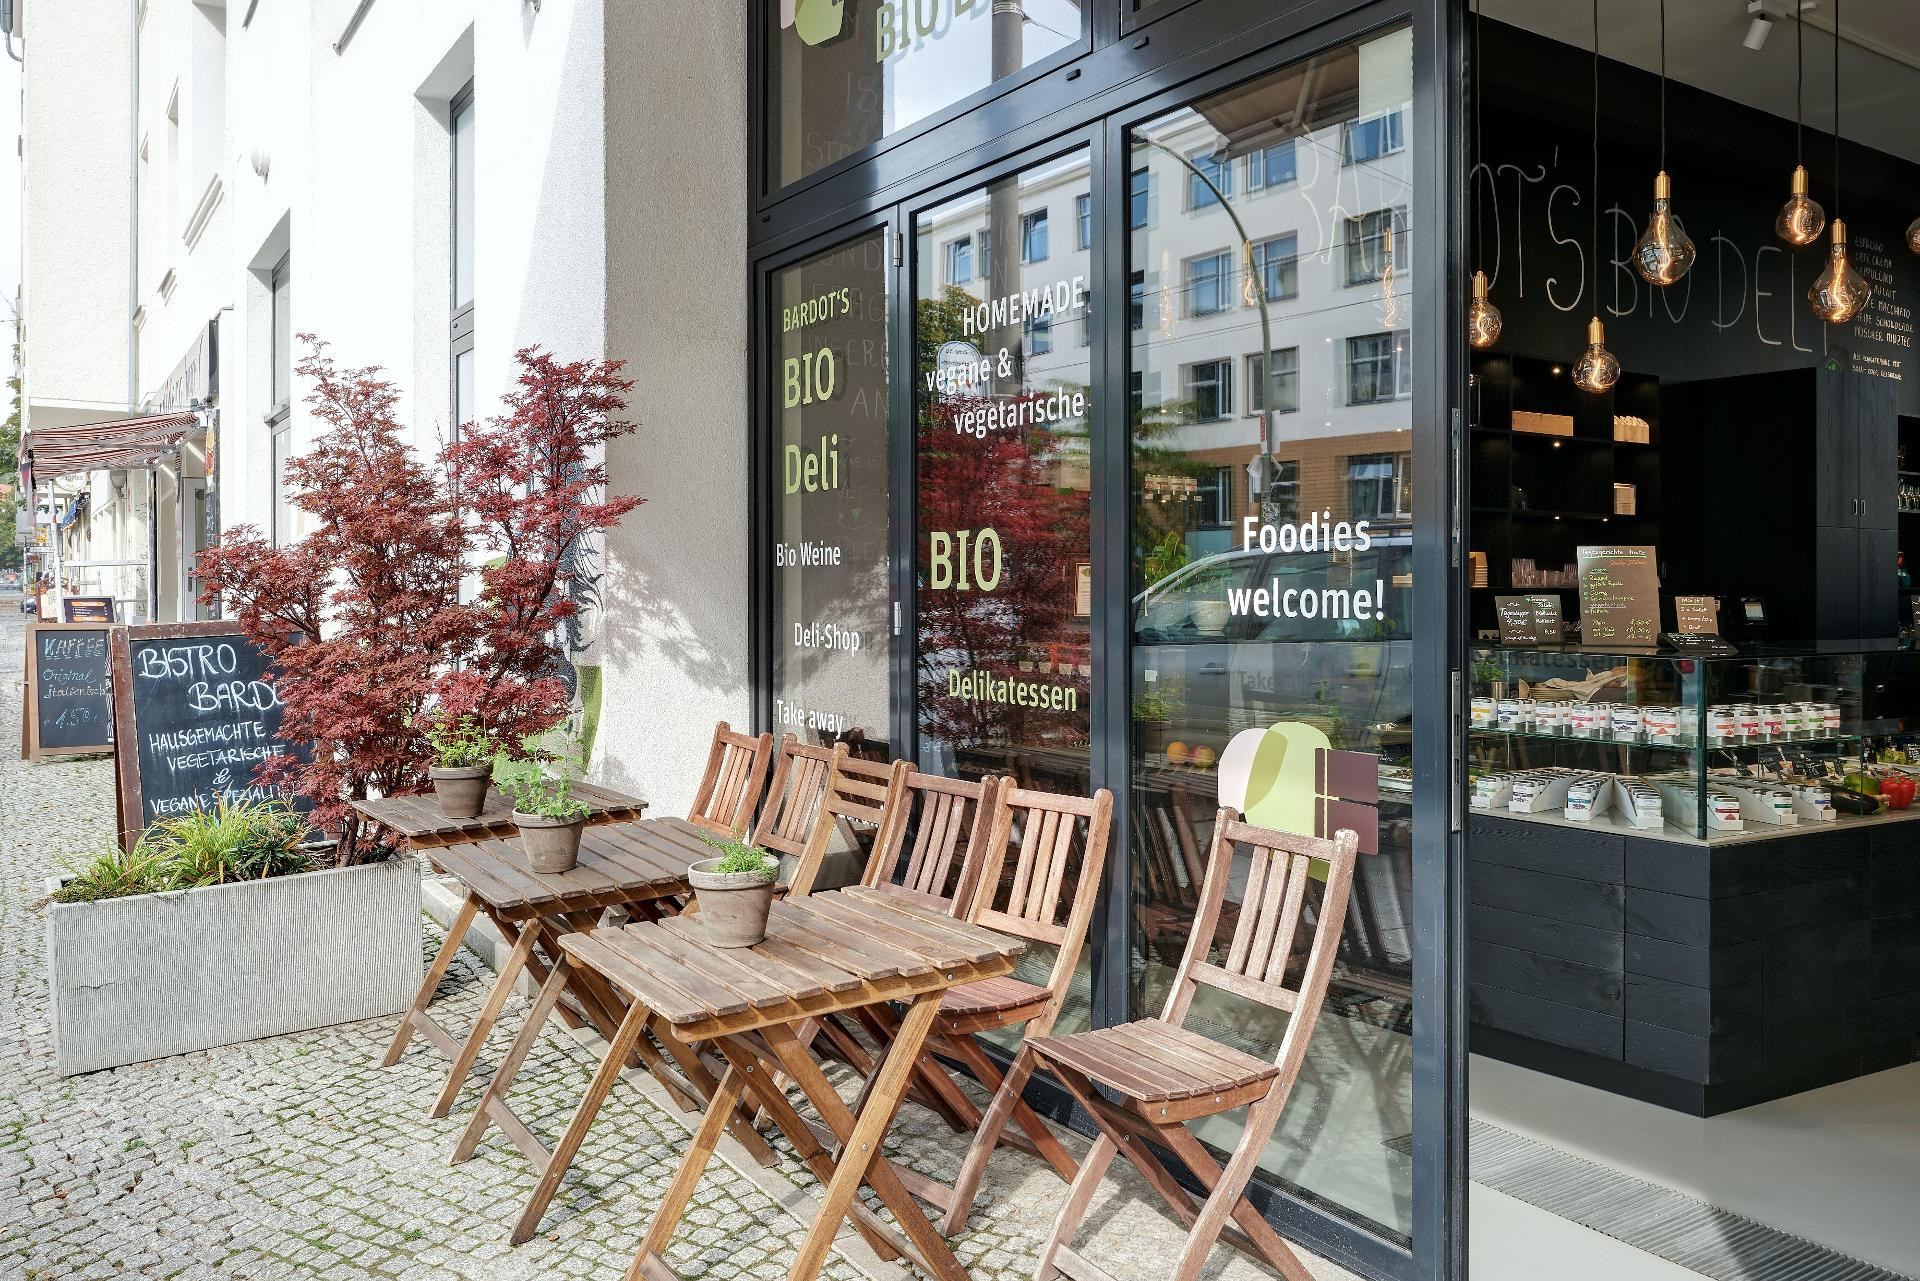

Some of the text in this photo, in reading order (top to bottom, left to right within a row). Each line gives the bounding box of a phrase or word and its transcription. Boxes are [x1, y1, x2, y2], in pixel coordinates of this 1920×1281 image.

[783, 287, 850, 332] BARDOT'S
[963, 275, 1085, 336] HOMEMADE
[784, 347, 835, 408] BIO
[926, 347, 1013, 395] vegane &
[954, 386, 1085, 439] vegetarische
[784, 433, 838, 494] Deli
[1243, 511, 1371, 553] Foodies
[776, 540, 841, 567] Bio Weine
[930, 527, 1002, 592] BIO
[1227, 578, 1384, 621] welcome!
[794, 622, 860, 657] Deli-Shop
[42, 668, 96, 685] Original
[138, 643, 237, 679] BISTRO
[948, 667, 1078, 712] Delikatessen
[148, 721, 266, 753] HAUSGEMACHTE
[776, 699, 844, 739] Take away
[167, 744, 286, 771] VEGETARISCHE
[150, 793, 211, 814] VEGANE
